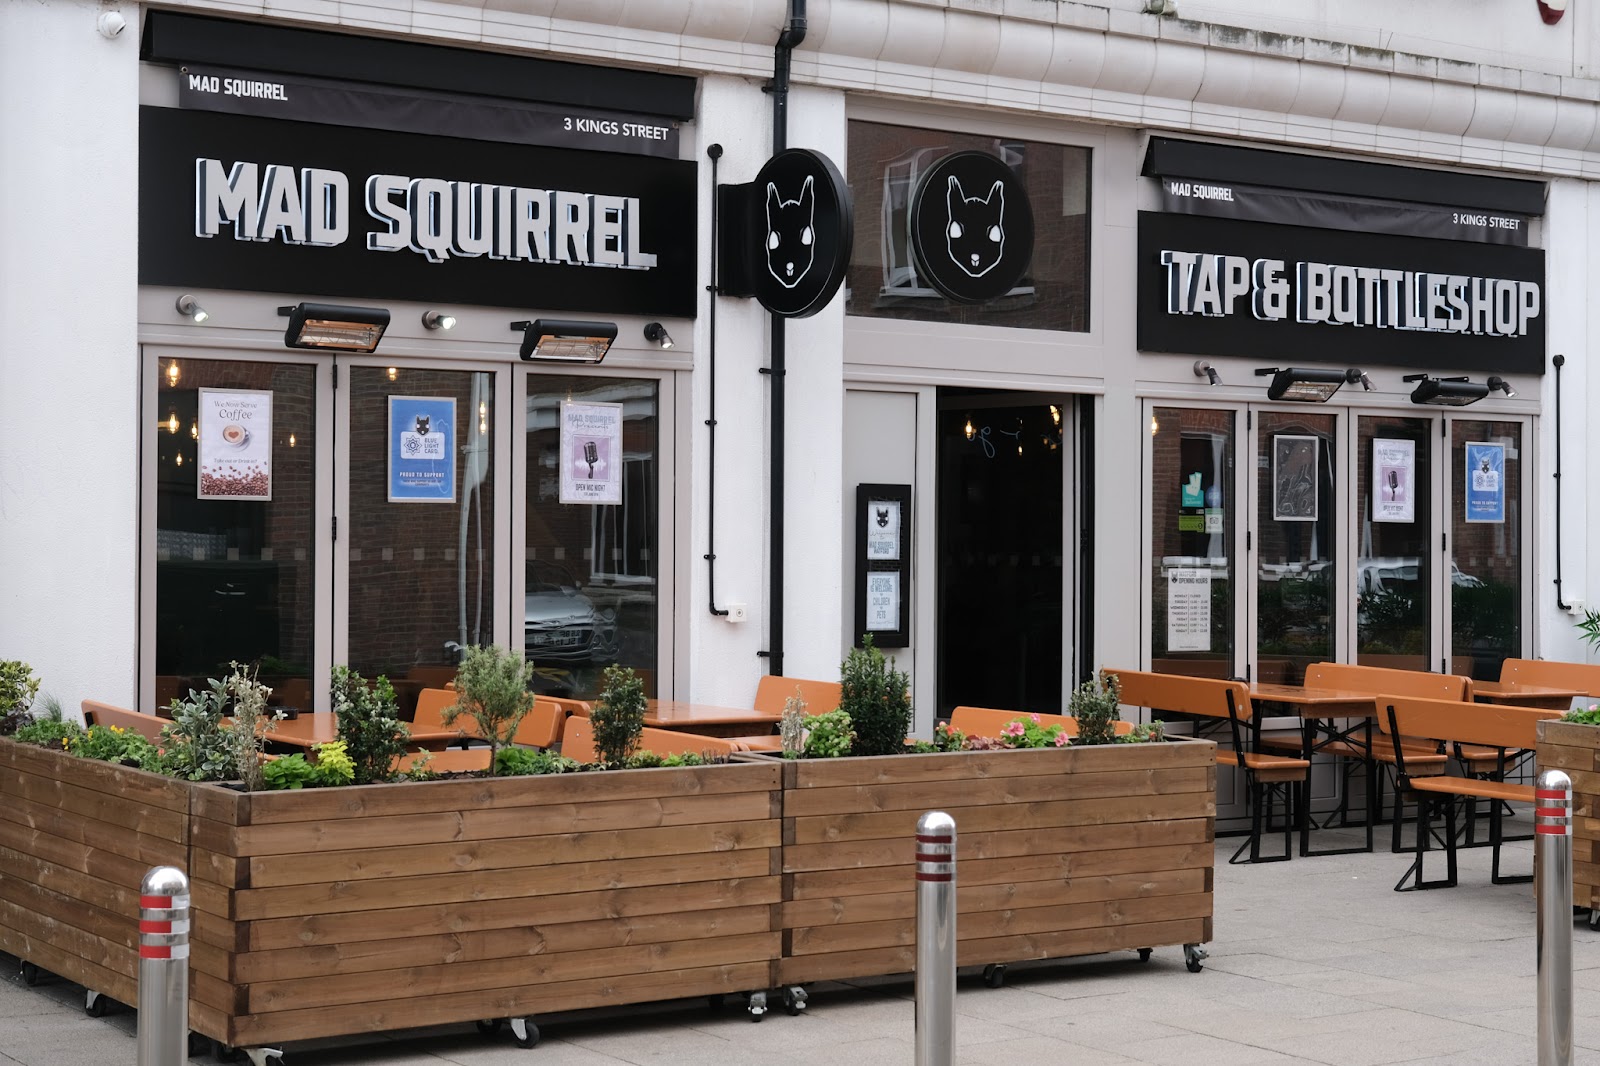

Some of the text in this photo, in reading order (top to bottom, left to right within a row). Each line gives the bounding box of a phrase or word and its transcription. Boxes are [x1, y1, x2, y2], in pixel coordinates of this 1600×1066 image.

[188, 74, 288, 102] MAD SQUIRREL
[563, 117, 669, 141] 3 KINGS STREET
[1170, 182, 1234, 202] MAD SQUIRREL
[195, 158, 658, 270] MAD SQUIRREL
[1452, 213, 1520, 230] 3 KINGS STREET
[1160, 250, 1540, 338] TAP & BOTTLESHOP
[219, 409, 252, 421] Coffee
[585, 415, 616, 424] SQUIRREL
[873, 597, 890, 606] CHILDREN
[877, 611, 886, 619] PETS
